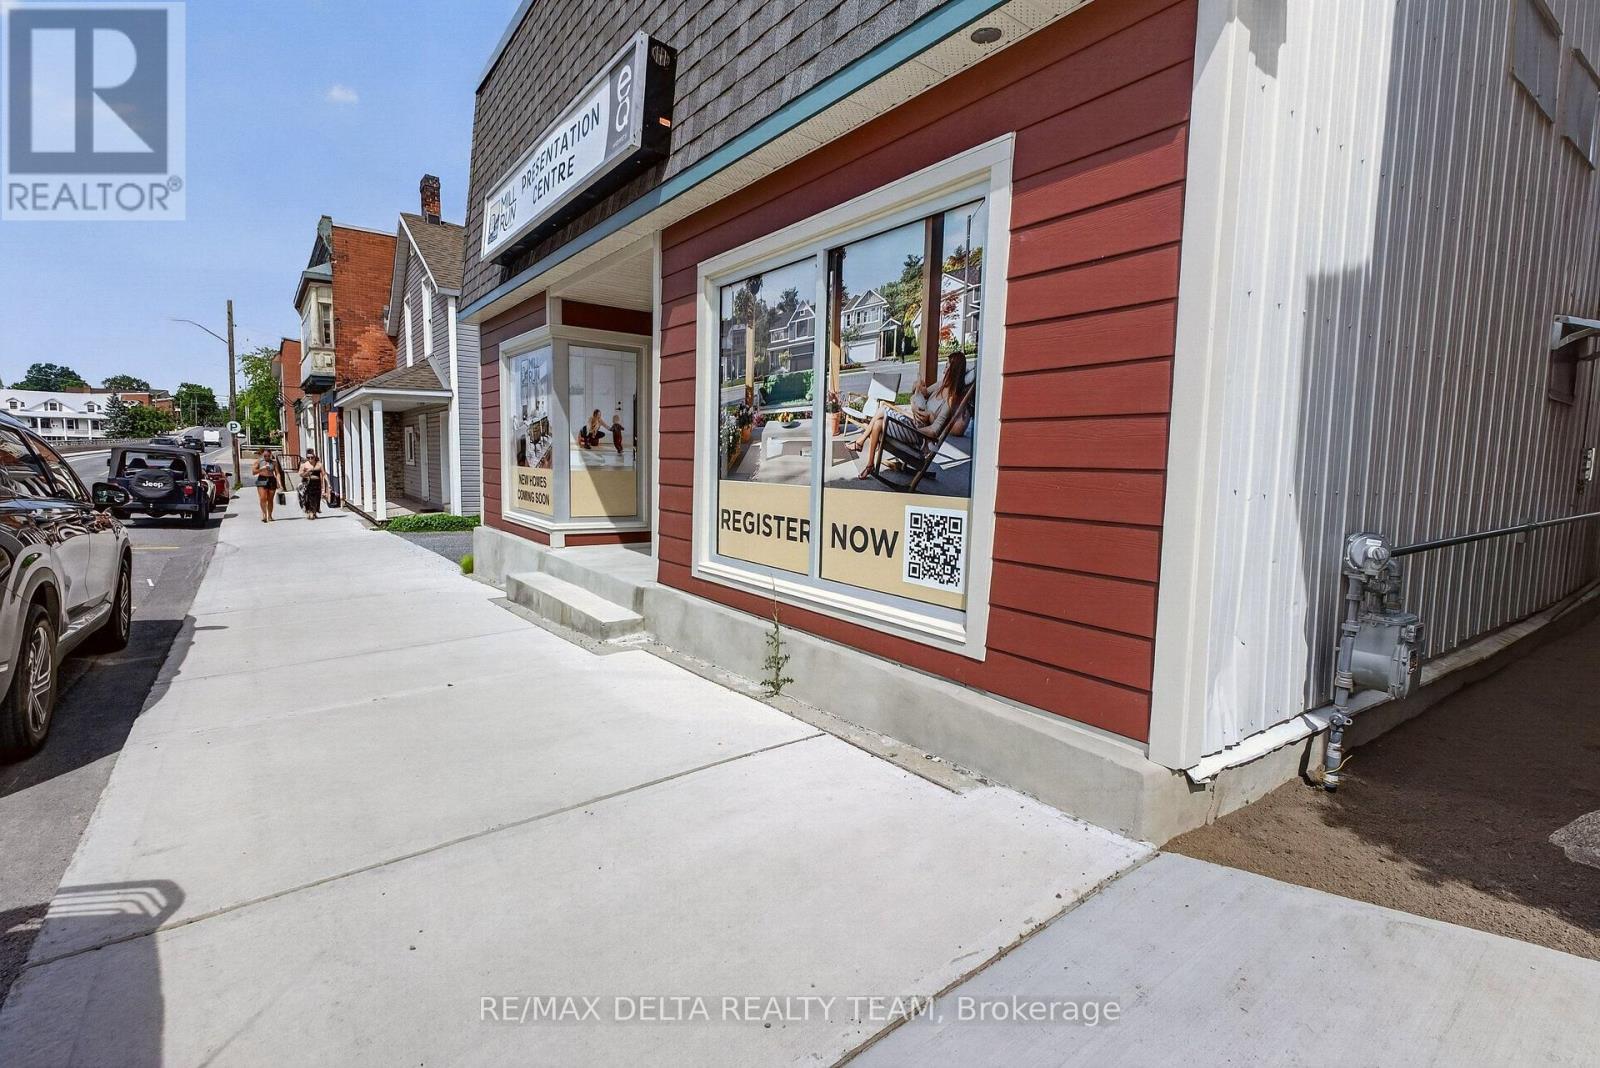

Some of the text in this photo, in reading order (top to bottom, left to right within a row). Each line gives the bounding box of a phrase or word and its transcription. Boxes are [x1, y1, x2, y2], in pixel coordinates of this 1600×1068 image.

[521, 102, 600, 195] PRESENTATION
[532, 154, 575, 205] CENTRE
[501, 187, 517, 213] MILL
[499, 204, 517, 231] RUN
[230, 423, 238, 431] P
[142, 481, 164, 489] Jeep
[519, 474, 547, 489] NEW HOMES
[518, 489, 550, 506] COMING SOON
[721, 508, 899, 559] REGISTER NOW
